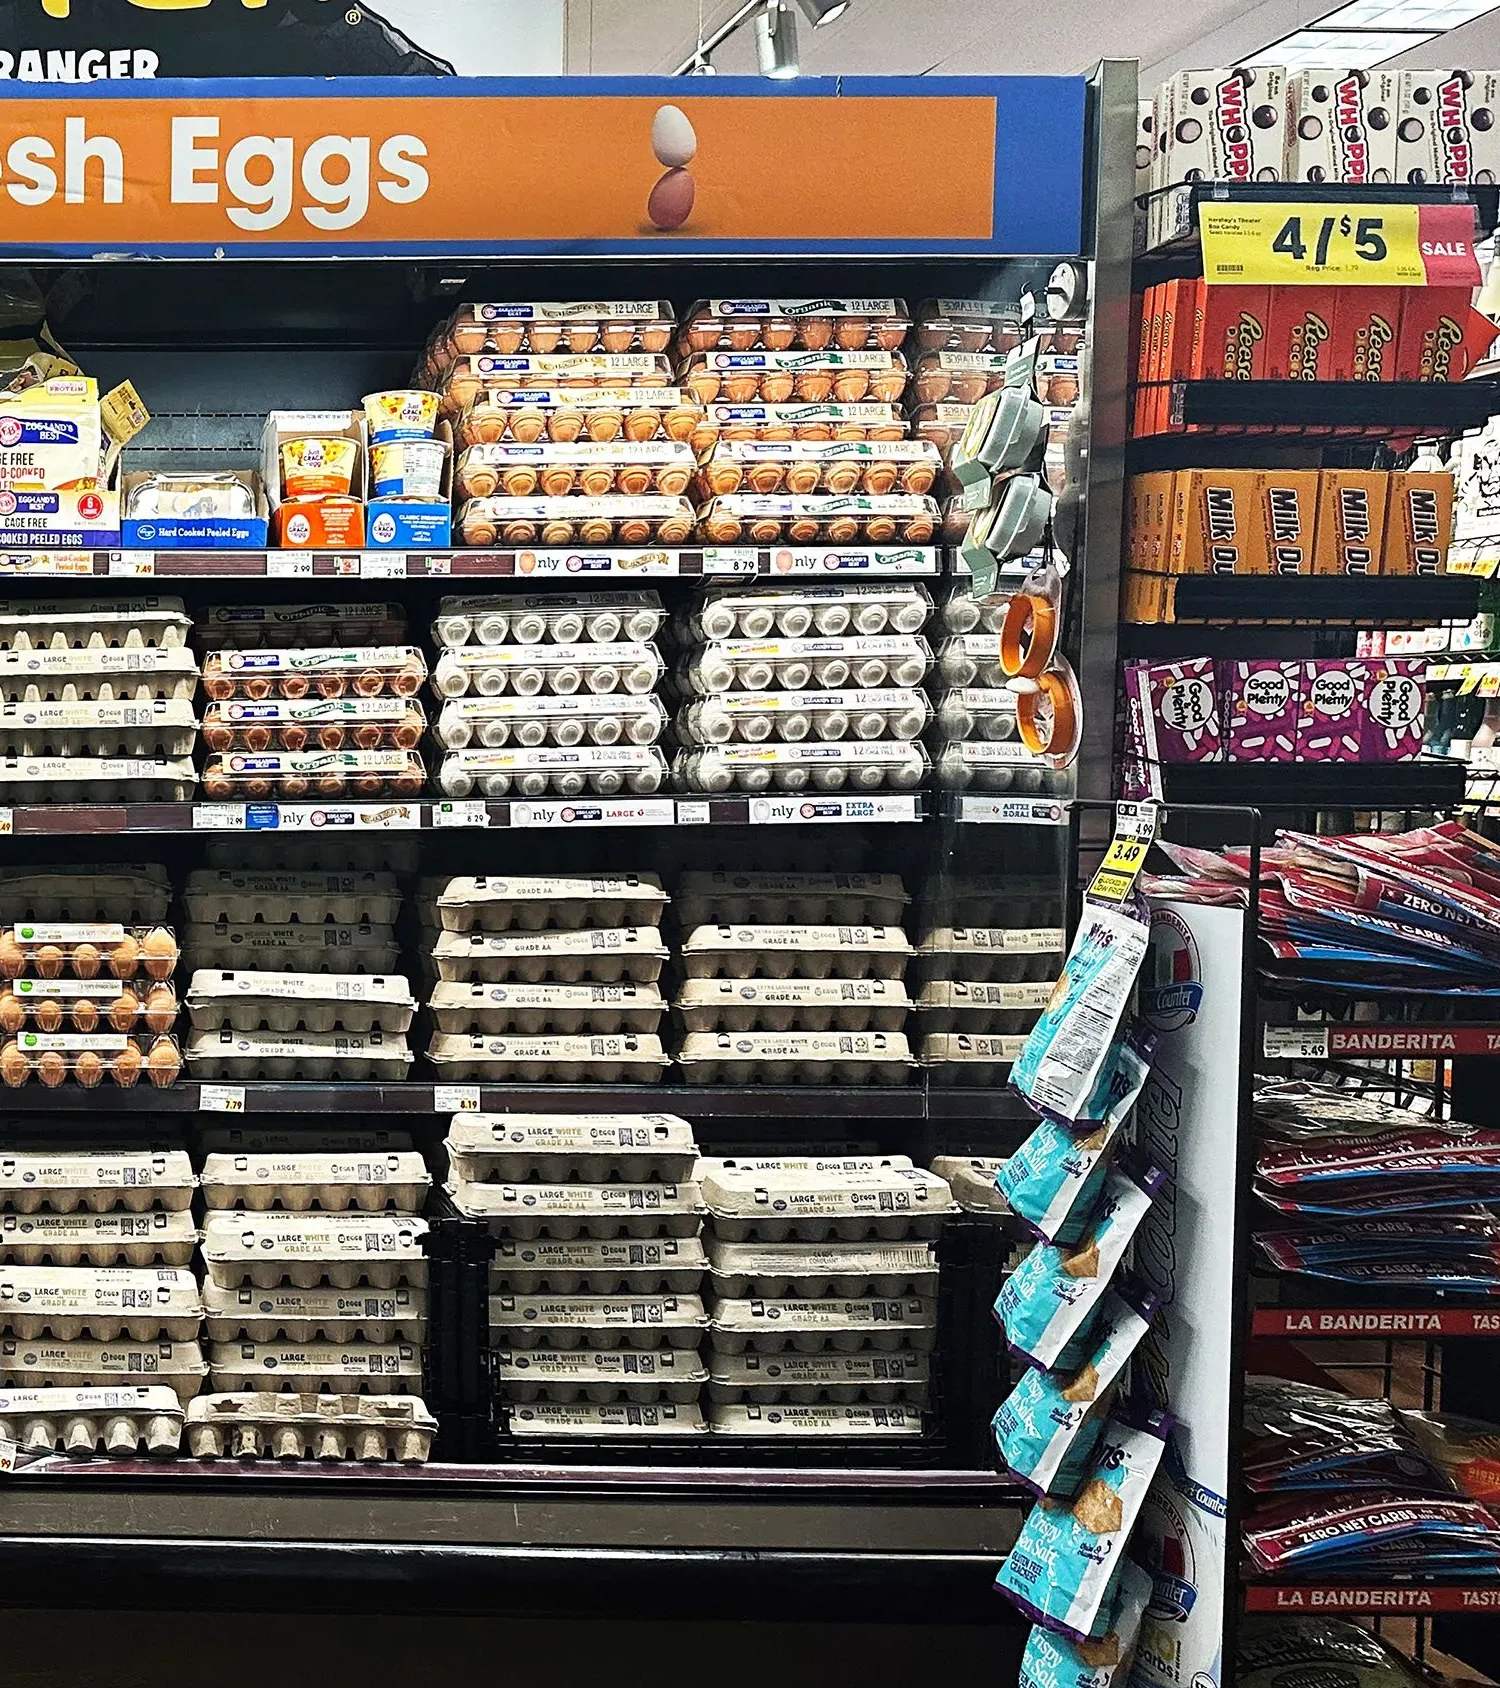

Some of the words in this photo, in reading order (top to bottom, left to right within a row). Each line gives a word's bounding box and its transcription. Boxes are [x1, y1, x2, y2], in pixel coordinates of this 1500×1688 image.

[171, 116, 429, 232] Eggs
[1221, 224, 1240, 232] Candy
[1422, 243, 1466, 256] SALE
[626, 303, 653, 313] LARGE
[862, 302, 890, 310] LARGE
[622, 357, 649, 366] LARGE
[781, 354, 831, 367] Organic
[782, 406, 830, 420] Organic
[39, 432, 60, 440] BEST
[11, 453, 34, 465] FREE
[87, 499, 93, 507] 6
[5, 518, 25, 527] CAGE
[27, 518, 48, 527] FREE
[29, 533, 60, 544] PEELED
[61, 534, 83, 544] EGGS
[158, 527, 177, 537] Hard
[178, 527, 205, 537] Cooked
[206, 527, 230, 537] Peeled
[231, 528, 250, 539] Eggs
[878, 551, 918, 564] Organic
[135, 564, 152, 574] 7.49
[1248, 679, 1284, 691] Good
[1315, 679, 1350, 691] Good
[1188, 683, 1204, 722] Good
[1247, 692, 1286, 707] Plenty
[1315, 692, 1351, 707] Plenty
[1377, 680, 1394, 726] Plenty
[1399, 683, 1411, 721] Good
[1172, 684, 1187, 728] Plenty
[772, 805, 794, 818] nly
[846, 802, 874, 810] EXTRA
[533, 811, 555, 822] nly
[1136, 824, 1153, 835] 4.99
[1114, 844, 1140, 861] 3.49
[1108, 887, 1124, 895] PRICE
[1403, 894, 1442, 915] ZERO
[1400, 923, 1452, 945] CARBS
[1156, 988, 1192, 1009] Counter
[1332, 1034, 1456, 1049] BANDERITA
[1301, 1045, 1324, 1056] 5.49
[225, 1101, 242, 1109] 7.79
[460, 1100, 477, 1109] 8.19
[527, 1128, 553, 1136] LARGE
[756, 1162, 781, 1170] LARGE
[783, 1162, 808, 1170] WHITE
[1387, 1156, 1439, 1169] CARBS
[39, 1168, 62, 1176] LARGE
[539, 1191, 564, 1199] LARGE
[818, 1194, 844, 1202] WHITE
[1365, 1222, 1414, 1233] CARBS
[1310, 1234, 1346, 1244] ZERO
[540, 1305, 566, 1313] LARGE
[1285, 1315, 1312, 1329] LA
[1320, 1315, 1441, 1329] BANDERITA
[532, 1354, 558, 1362] LARGE
[1030, 1511, 1062, 1542] Crispy
[1299, 1528, 1339, 1543] ZERO
[1340, 1519, 1367, 1534] NET
[1369, 1510, 1417, 1526] CARBS
[1029, 1561, 1044, 1576] FREE
[1278, 1592, 1300, 1605] LA
[1310, 1592, 1432, 1605] BANDERITA
